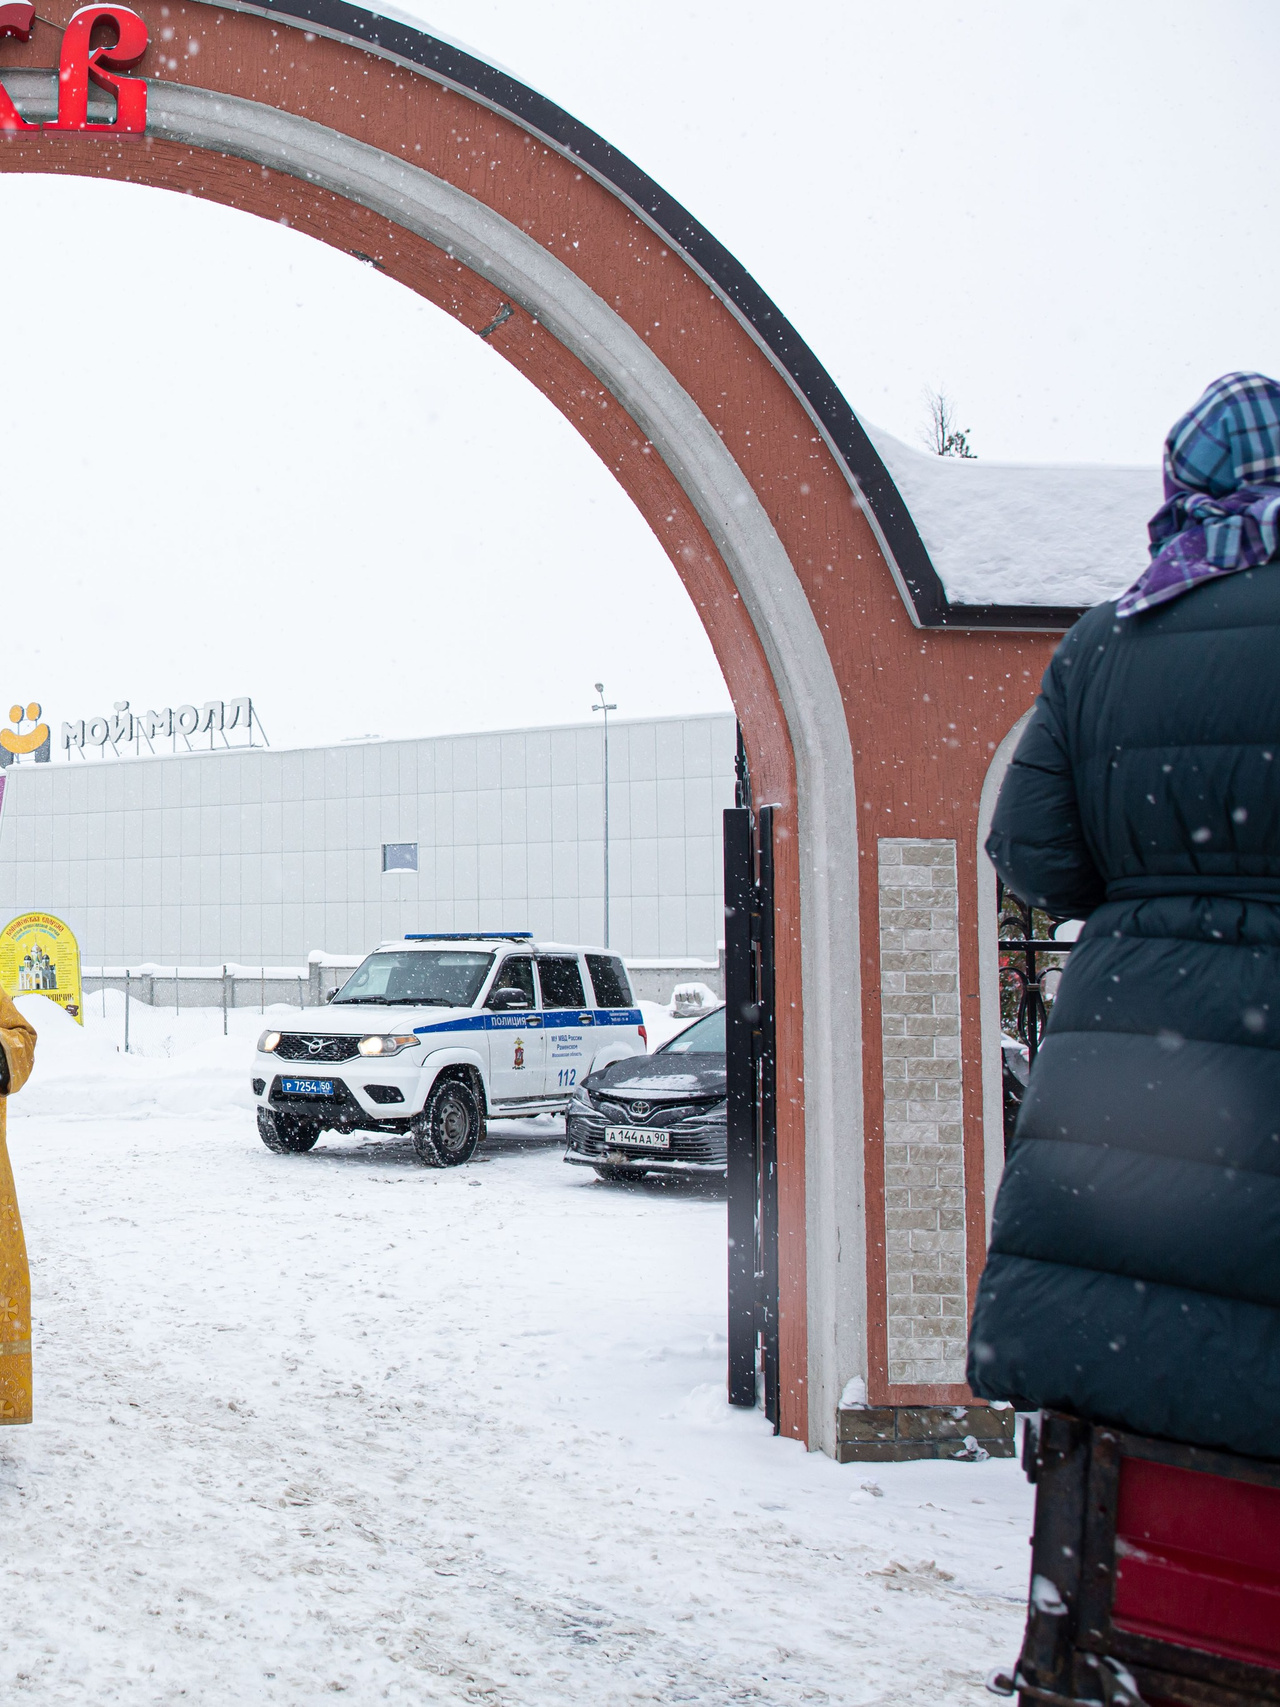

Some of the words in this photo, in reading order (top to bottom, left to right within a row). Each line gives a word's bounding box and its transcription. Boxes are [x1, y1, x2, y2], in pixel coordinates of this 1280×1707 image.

[61, 701, 133, 749] МОЙ
[147, 697, 251, 739] МОЛЛ
[491, 1016, 527, 1027] ПОЛИЦИЯ
[558, 1034, 568, 1042] МВД
[568, 1034, 582, 1042] России
[558, 1068, 577, 1087] 112
